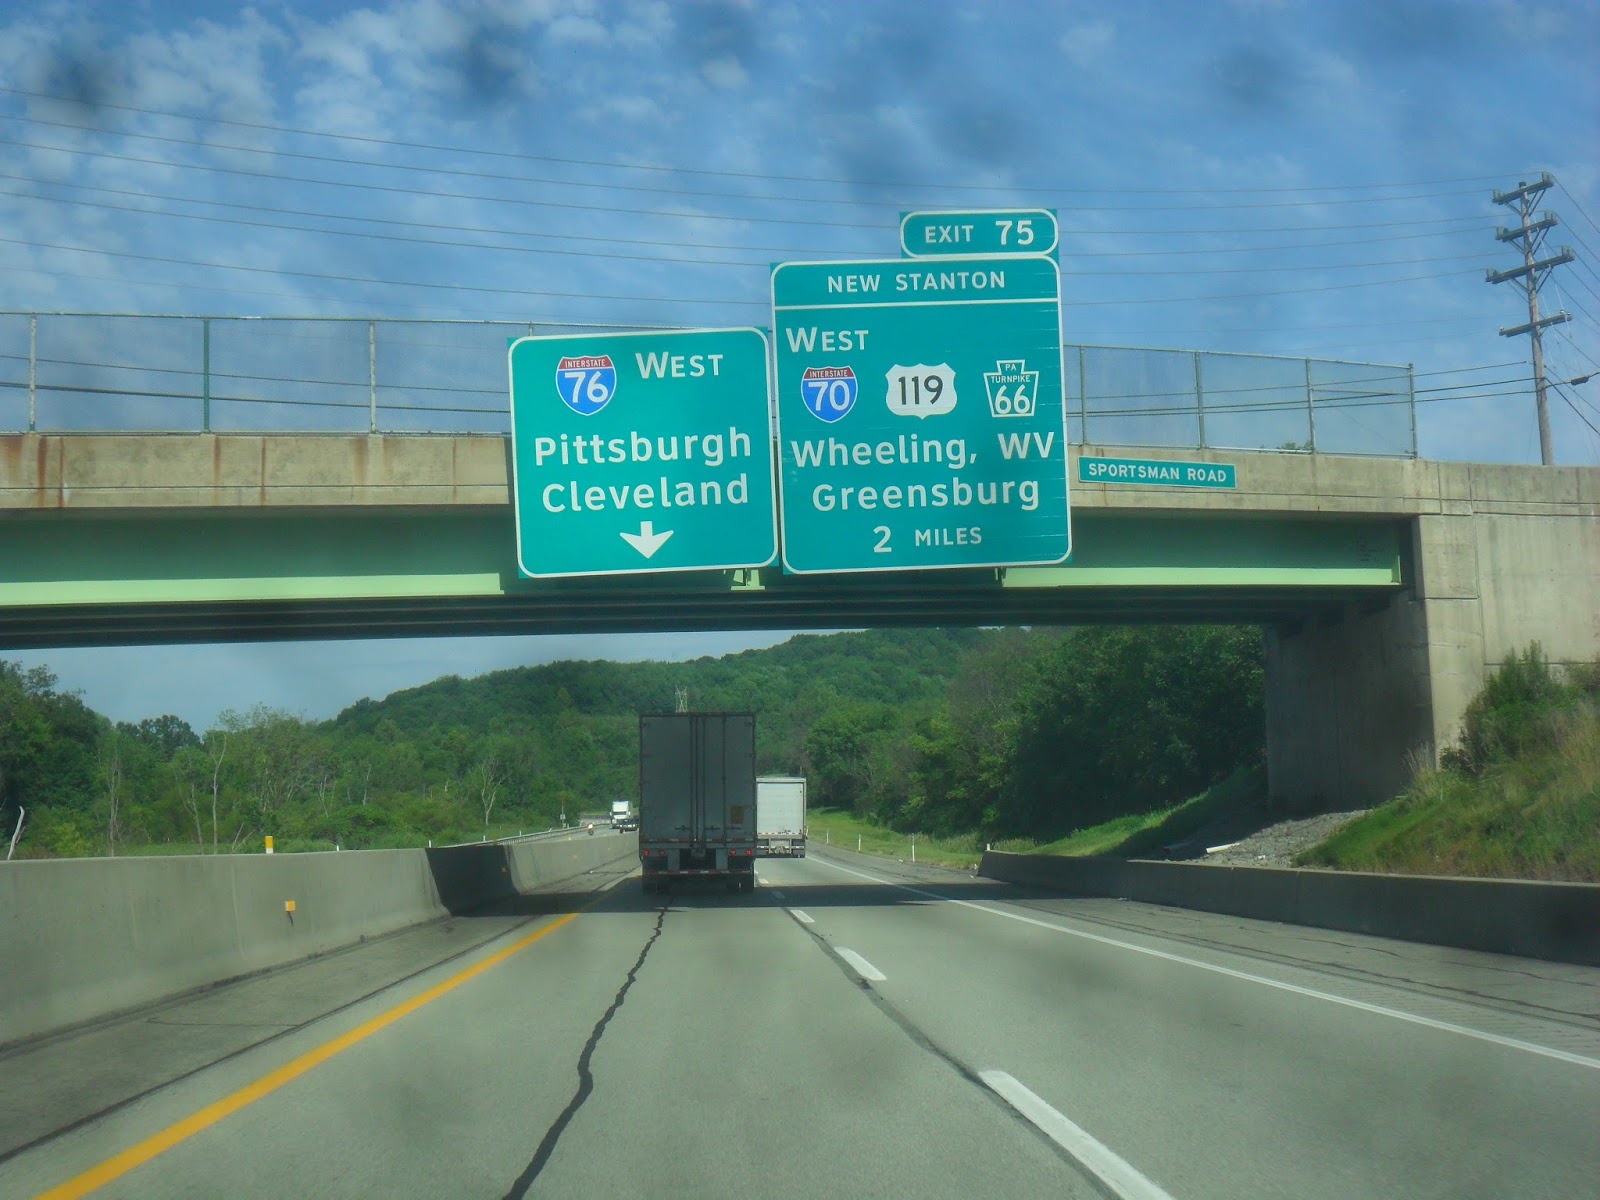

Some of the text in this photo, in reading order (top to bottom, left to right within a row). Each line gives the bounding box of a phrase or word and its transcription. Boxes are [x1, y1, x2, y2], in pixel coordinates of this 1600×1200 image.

[925, 220, 1034, 245] EXIT 75
[827, 271, 1004, 292] NEW STANTON
[785, 327, 868, 352] WEST
[564, 358, 606, 367] INTERSTATE
[635, 351, 723, 378] WEST
[809, 369, 847, 377] INTERSTATE
[1004, 363, 1016, 371] PA
[564, 371, 608, 403] 76
[898, 374, 943, 405] 119
[990, 374, 1030, 383] TURNPIKE
[807, 380, 849, 410] 70
[994, 384, 1030, 414] 66
[534, 426, 750, 466] Pittsburgh
[791, 431, 1054, 468] Wheeling, WV
[1088, 463, 1226, 482] SPORTSMAN ROAD
[542, 473, 748, 512] Cleveland
[812, 477, 1038, 511] Greensburg
[873, 525, 982, 552] 2 MILES
